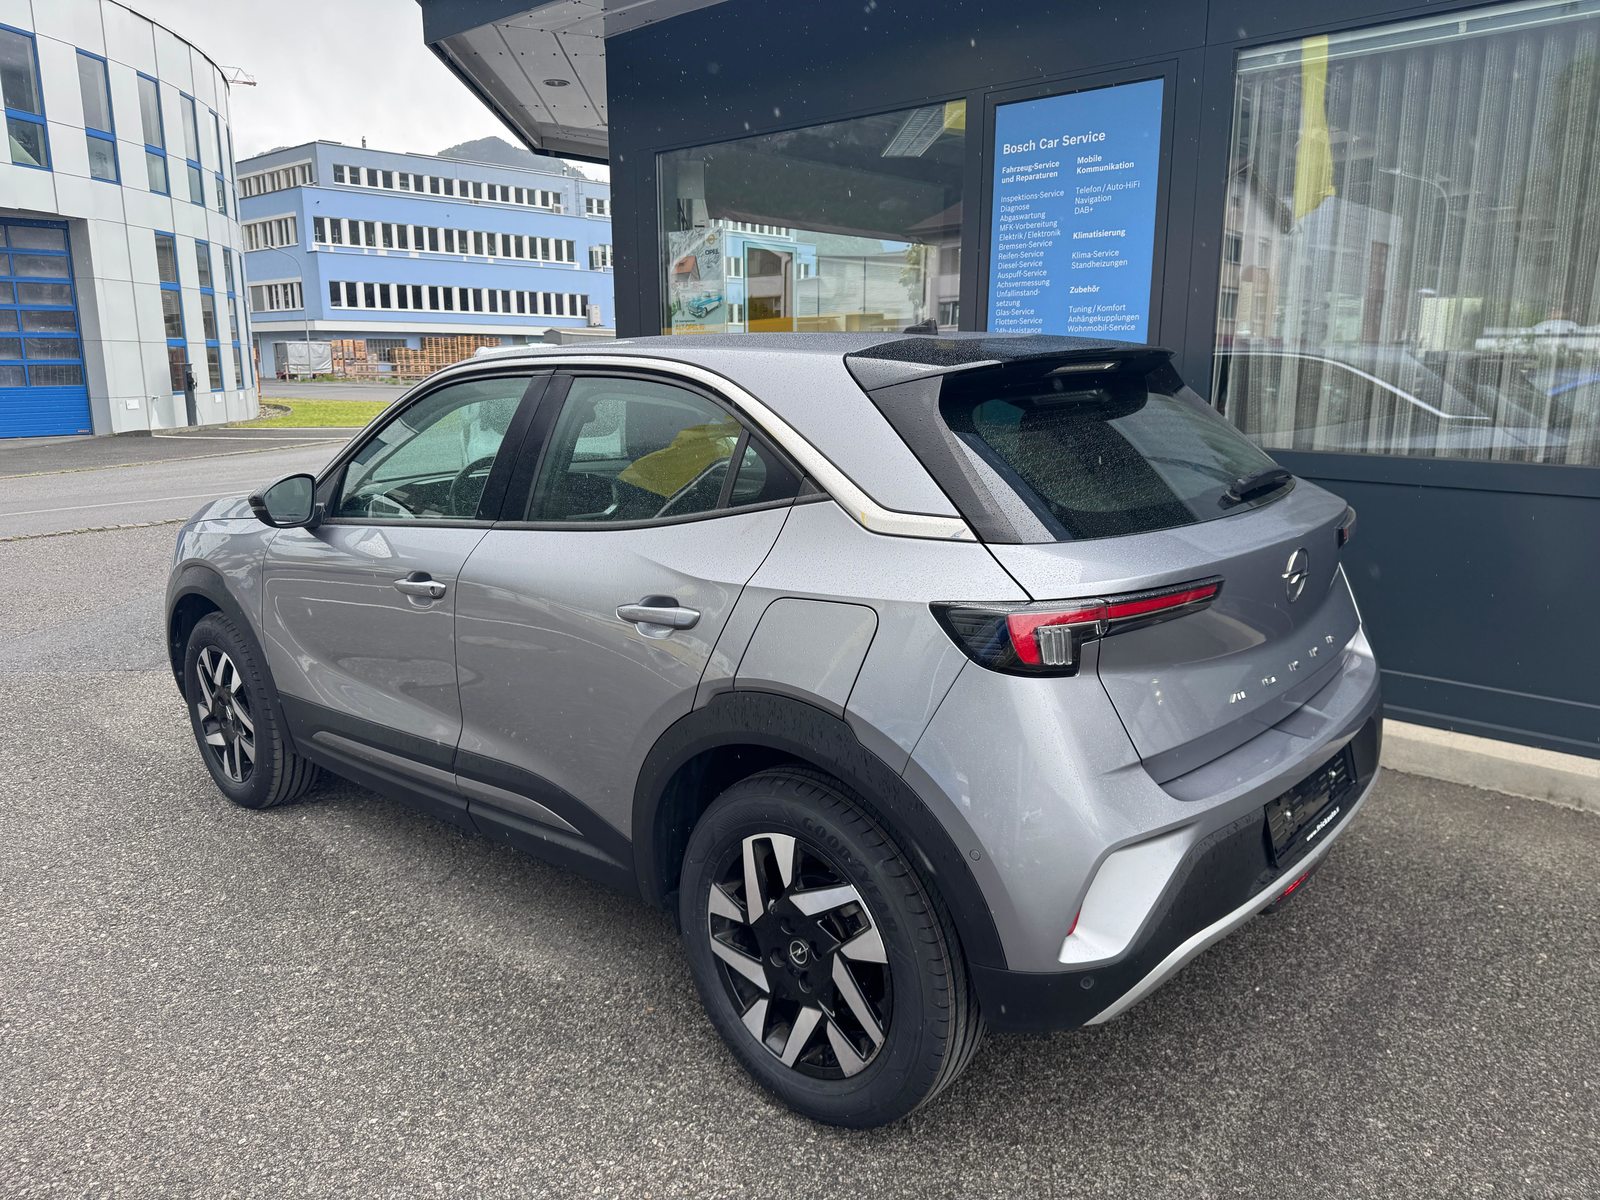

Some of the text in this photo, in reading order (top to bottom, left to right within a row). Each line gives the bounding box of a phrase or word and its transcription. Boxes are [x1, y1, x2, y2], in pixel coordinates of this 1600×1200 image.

[1003, 130, 1106, 154] Bosch Car Service
[1076, 154, 1102, 164] Mobile
[1002, 160, 1060, 174] Fahrzeug-Service
[1076, 161, 1134, 174] Kommunikation
[1002, 171, 1058, 184] und Reparaturen
[1000, 190, 1064, 204] Inspektions-Service
[1074, 194, 1112, 205] Navigation
[1000, 204, 1030, 213] Diagnose
[1074, 206, 1093, 214] DAB+
[1000, 212, 1046, 222] Abgaswartung
[1000, 220, 1058, 232] MFK-Vorbereitung
[1072, 229, 1126, 240] Klimatisierung
[998, 240, 1053, 250] Bremsen-Service
[998, 250, 1044, 260] Reifen-Service
[1072, 250, 1120, 260] Klima-Service
[998, 260, 1043, 270] Diesel-Service
[1072, 259, 1128, 270] Standheizungen
[997, 270, 1048, 280] Auspuff-Service
[996, 280, 1050, 288] Achsvermessung
[1070, 284, 1100, 294] Zubehör
[996, 288, 1040, 298] Unfallinstand-
[996, 308, 1034, 316] Glas-Service
[995, 317, 1043, 326] Flotten-Service
[1068, 314, 1140, 323] Anhängekupplungen
[1067, 323, 1136, 332] Wohnmobil-Service
